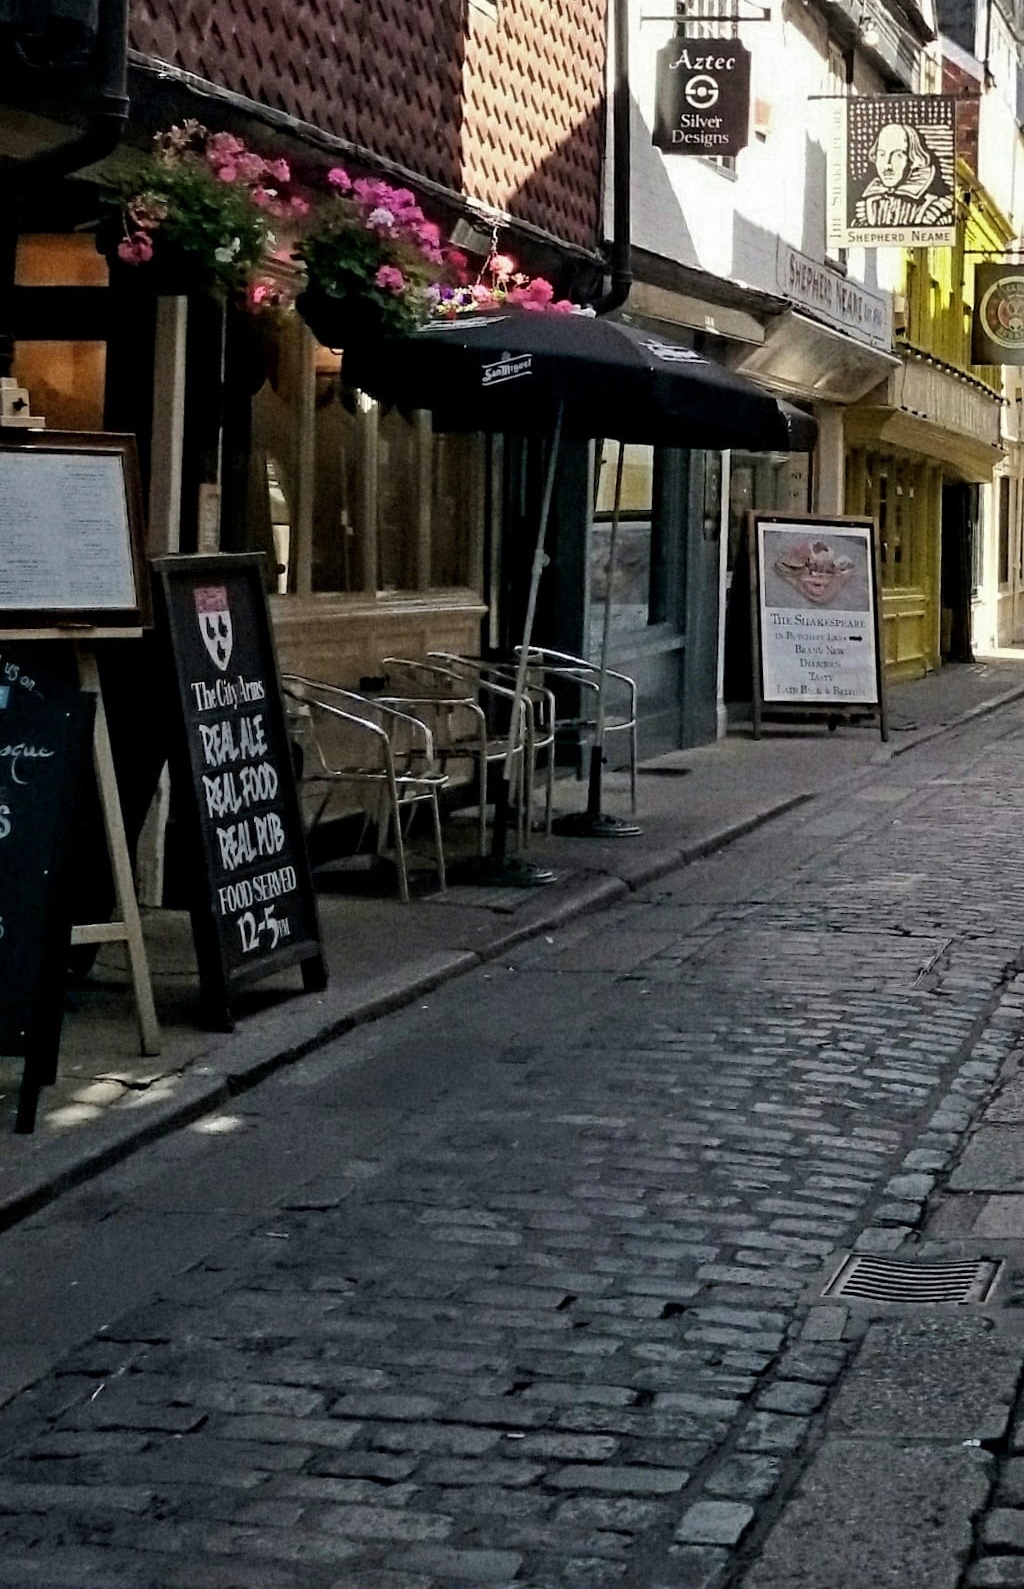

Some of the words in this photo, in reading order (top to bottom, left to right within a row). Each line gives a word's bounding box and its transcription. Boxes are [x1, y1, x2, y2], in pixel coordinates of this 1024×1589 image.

[669, 49, 736, 70] Aztec
[680, 114, 723, 128] Silver
[672, 130, 729, 147] Designs
[848, 231, 905, 243] SHEPHERD
[911, 230, 950, 242] NEAME
[770, 613, 792, 625] THE
[794, 614, 866, 628] SHAKESPEARE
[190, 681, 217, 711] The
[215, 678, 238, 710] City
[238, 675, 265, 702] Arms
[199, 720, 240, 767] REAL
[240, 713, 268, 760] ALE
[202, 772, 242, 818] REAL
[239, 761, 278, 807] FOOD
[216, 819, 258, 871] REAL
[254, 812, 285, 855] PUB
[217, 880, 254, 915] FOOD
[252, 865, 297, 902] SERVED
